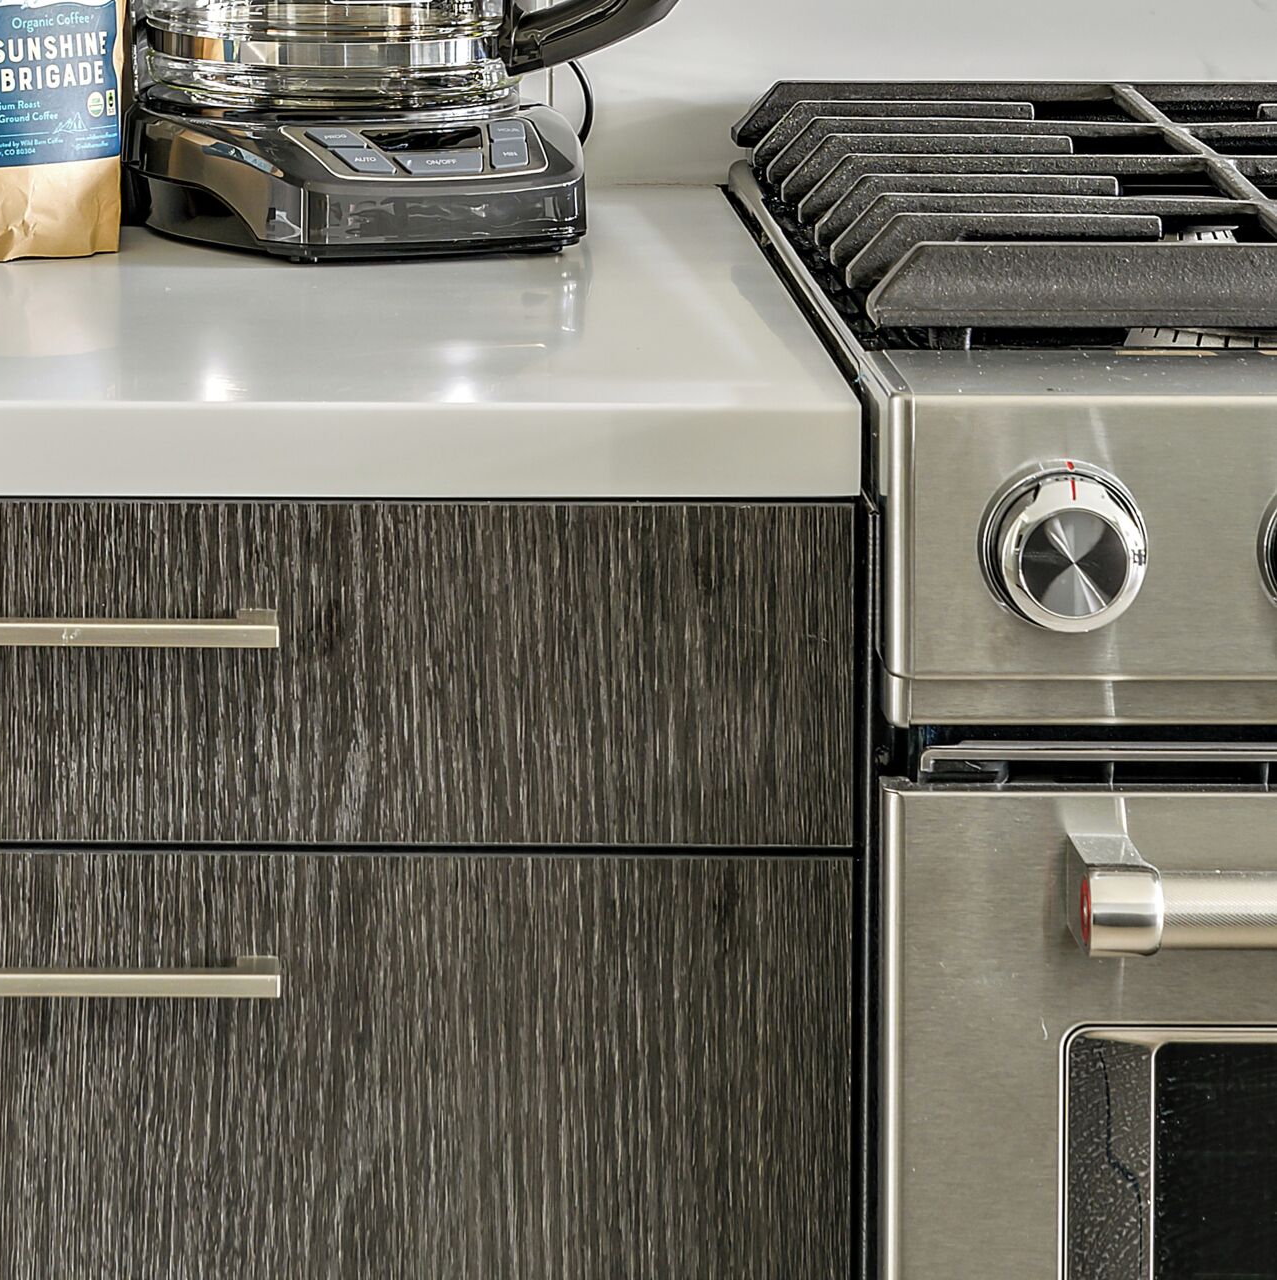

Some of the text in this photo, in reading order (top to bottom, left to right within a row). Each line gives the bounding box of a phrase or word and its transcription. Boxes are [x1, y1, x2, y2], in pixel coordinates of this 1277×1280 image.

[12, 12, 90, 32] Organic Coffee
[0, 61, 104, 92] BRIGADE
[17, 101, 41, 109] Roast
[32, 111, 59, 120] Coffee
[12, 140, 20, 149] by
